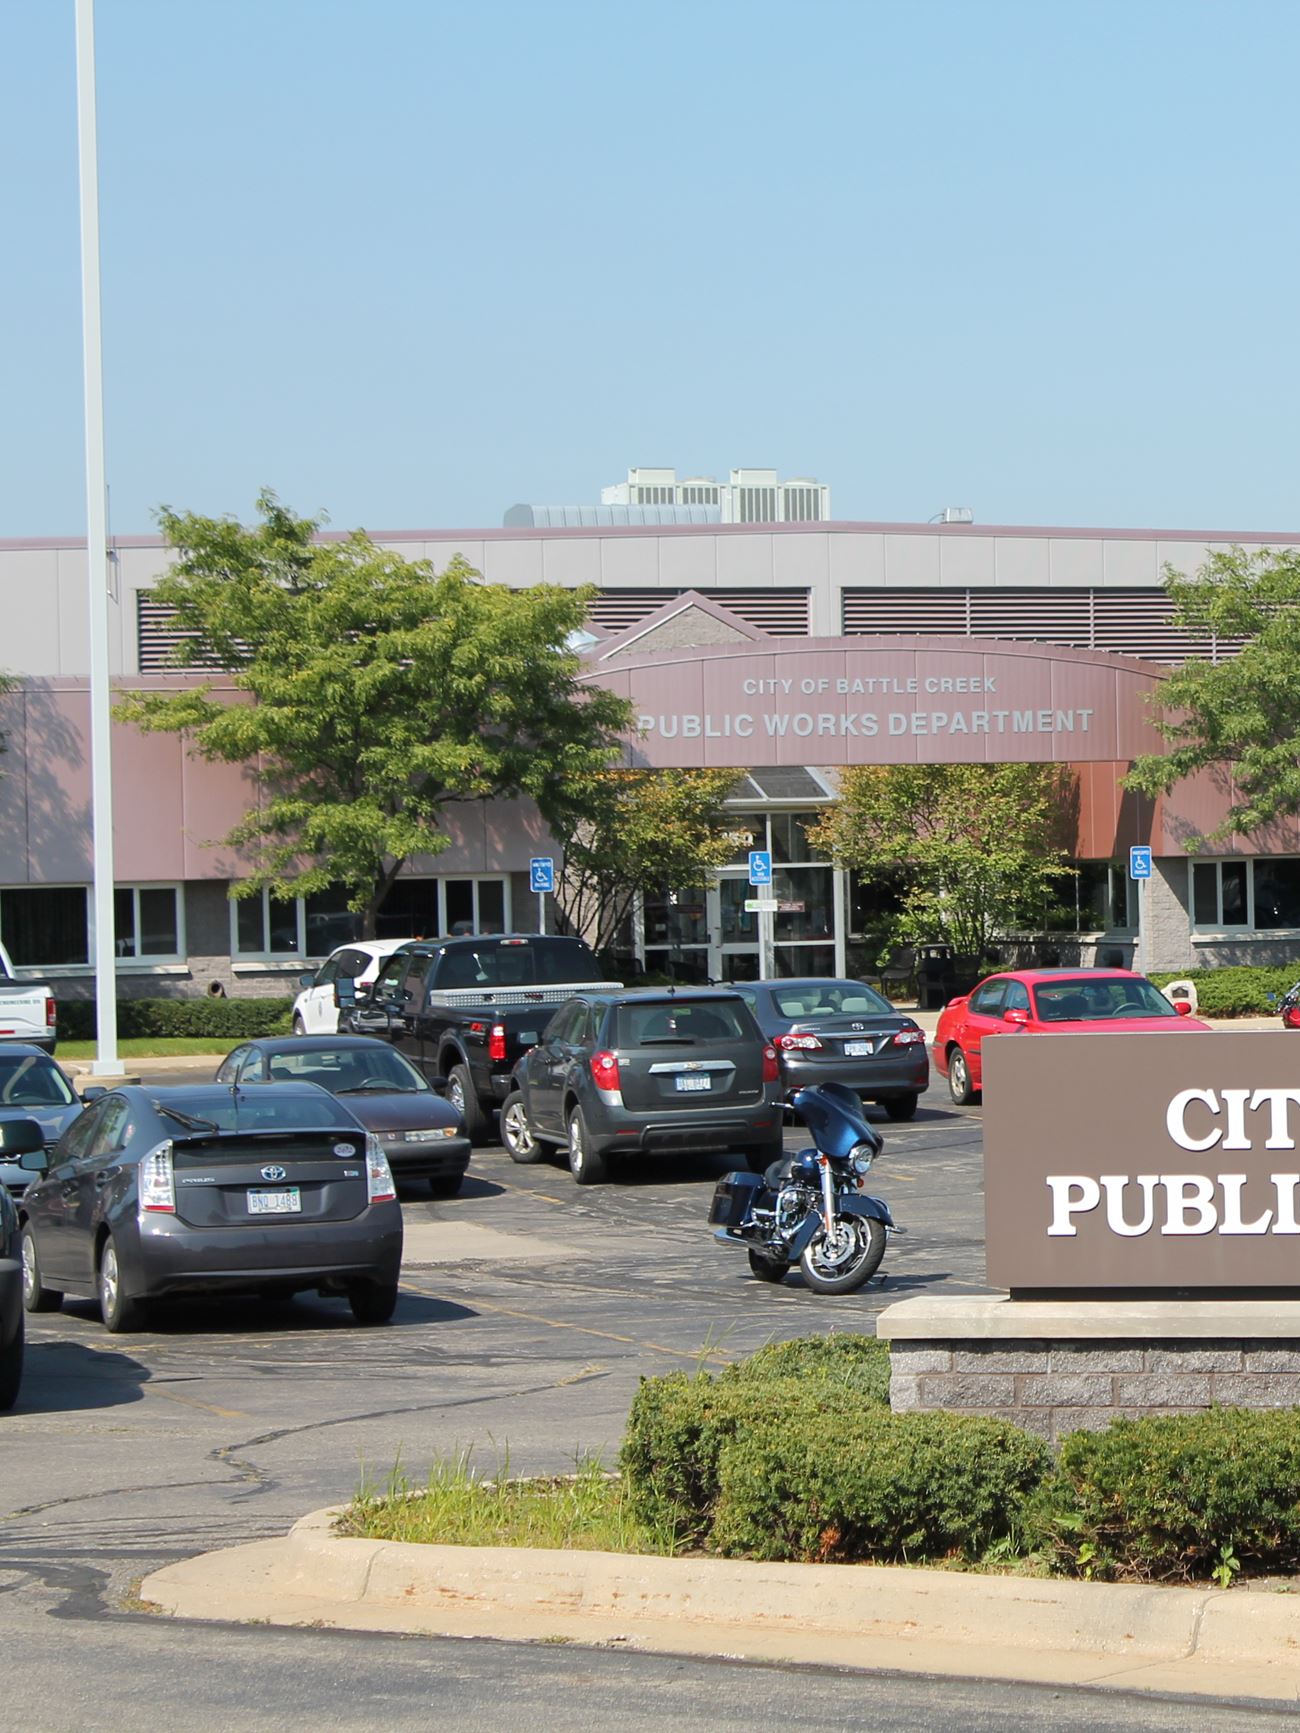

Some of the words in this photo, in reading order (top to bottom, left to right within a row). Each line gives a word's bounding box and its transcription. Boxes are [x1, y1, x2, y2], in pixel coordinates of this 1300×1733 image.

[742, 678, 794, 695] CITY
[800, 678, 830, 695] OF
[836, 677, 918, 694] BATTLE
[924, 676, 998, 693] CREEK
[637, 713, 754, 738] PUBLIC
[763, 712, 879, 737] WORKS
[887, 708, 1094, 736] DEPARTMENT
